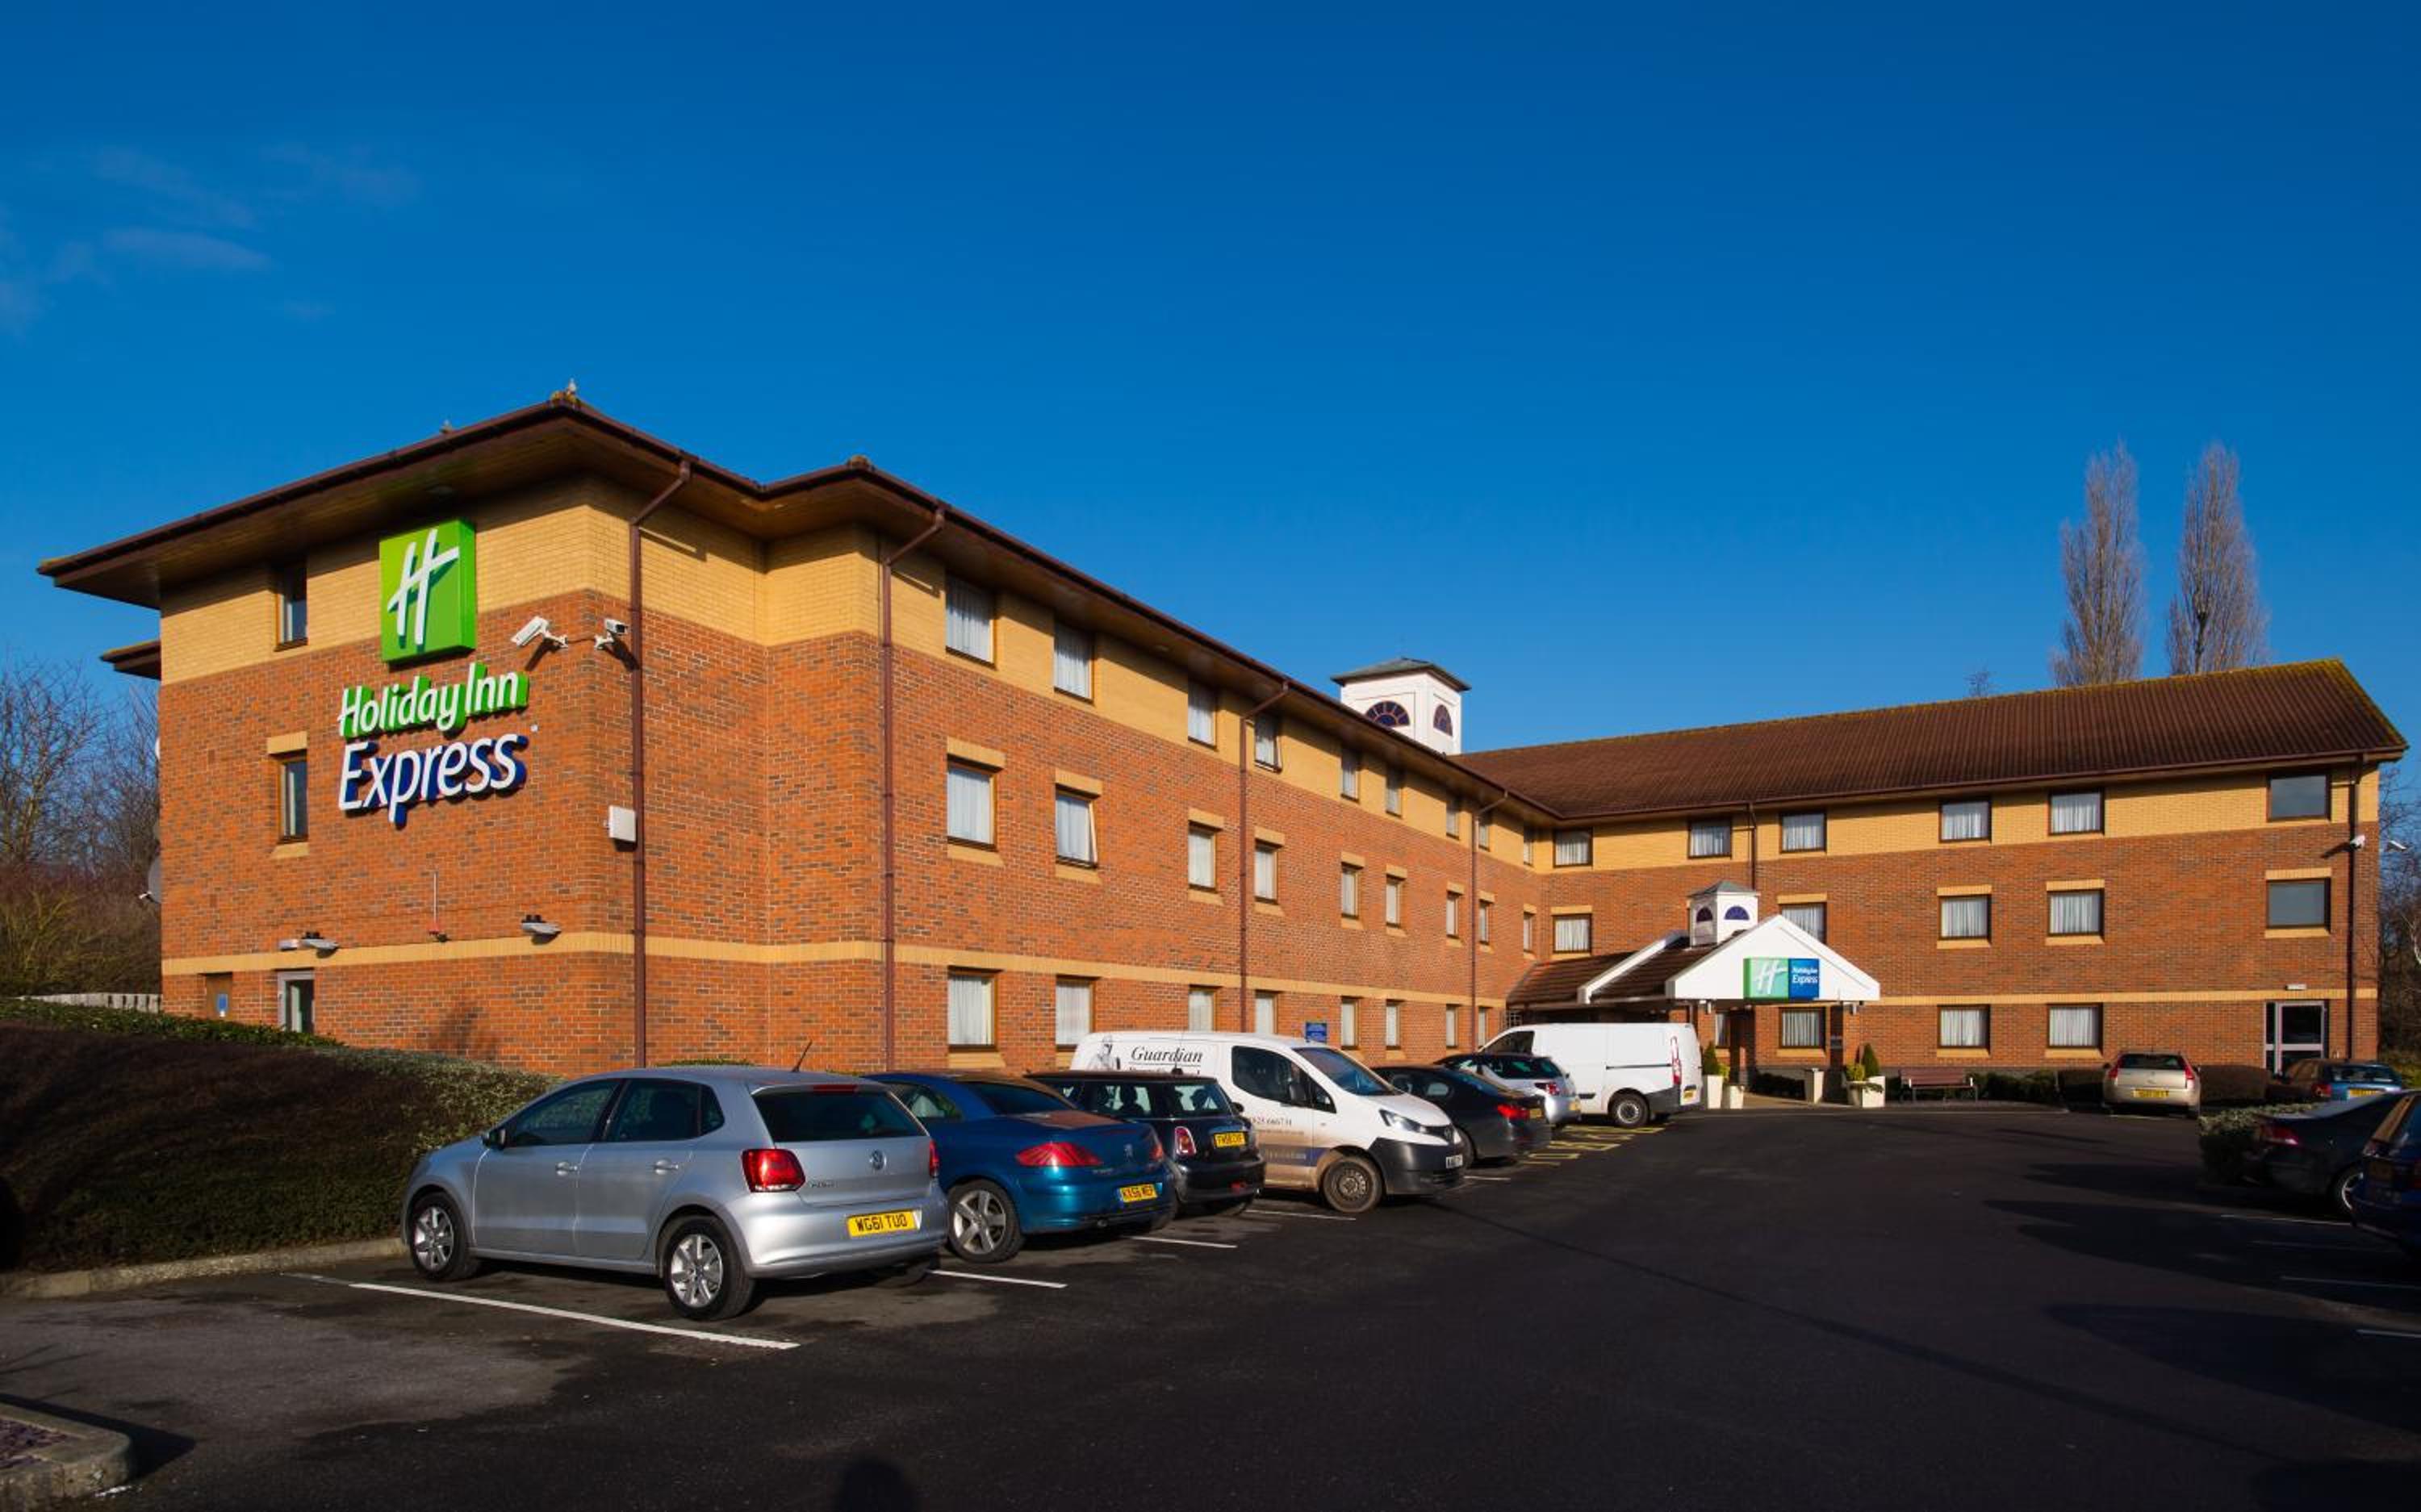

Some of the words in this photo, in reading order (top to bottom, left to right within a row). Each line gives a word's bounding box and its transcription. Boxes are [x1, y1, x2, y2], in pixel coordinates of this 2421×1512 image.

[337, 675, 464, 733] Holiday
[465, 662, 524, 717] Inn
[338, 733, 523, 824] Express
[1792, 975, 1818, 985] Express
[1131, 1046, 1202, 1063] Guardian
[855, 1216, 884, 1232] WG61
